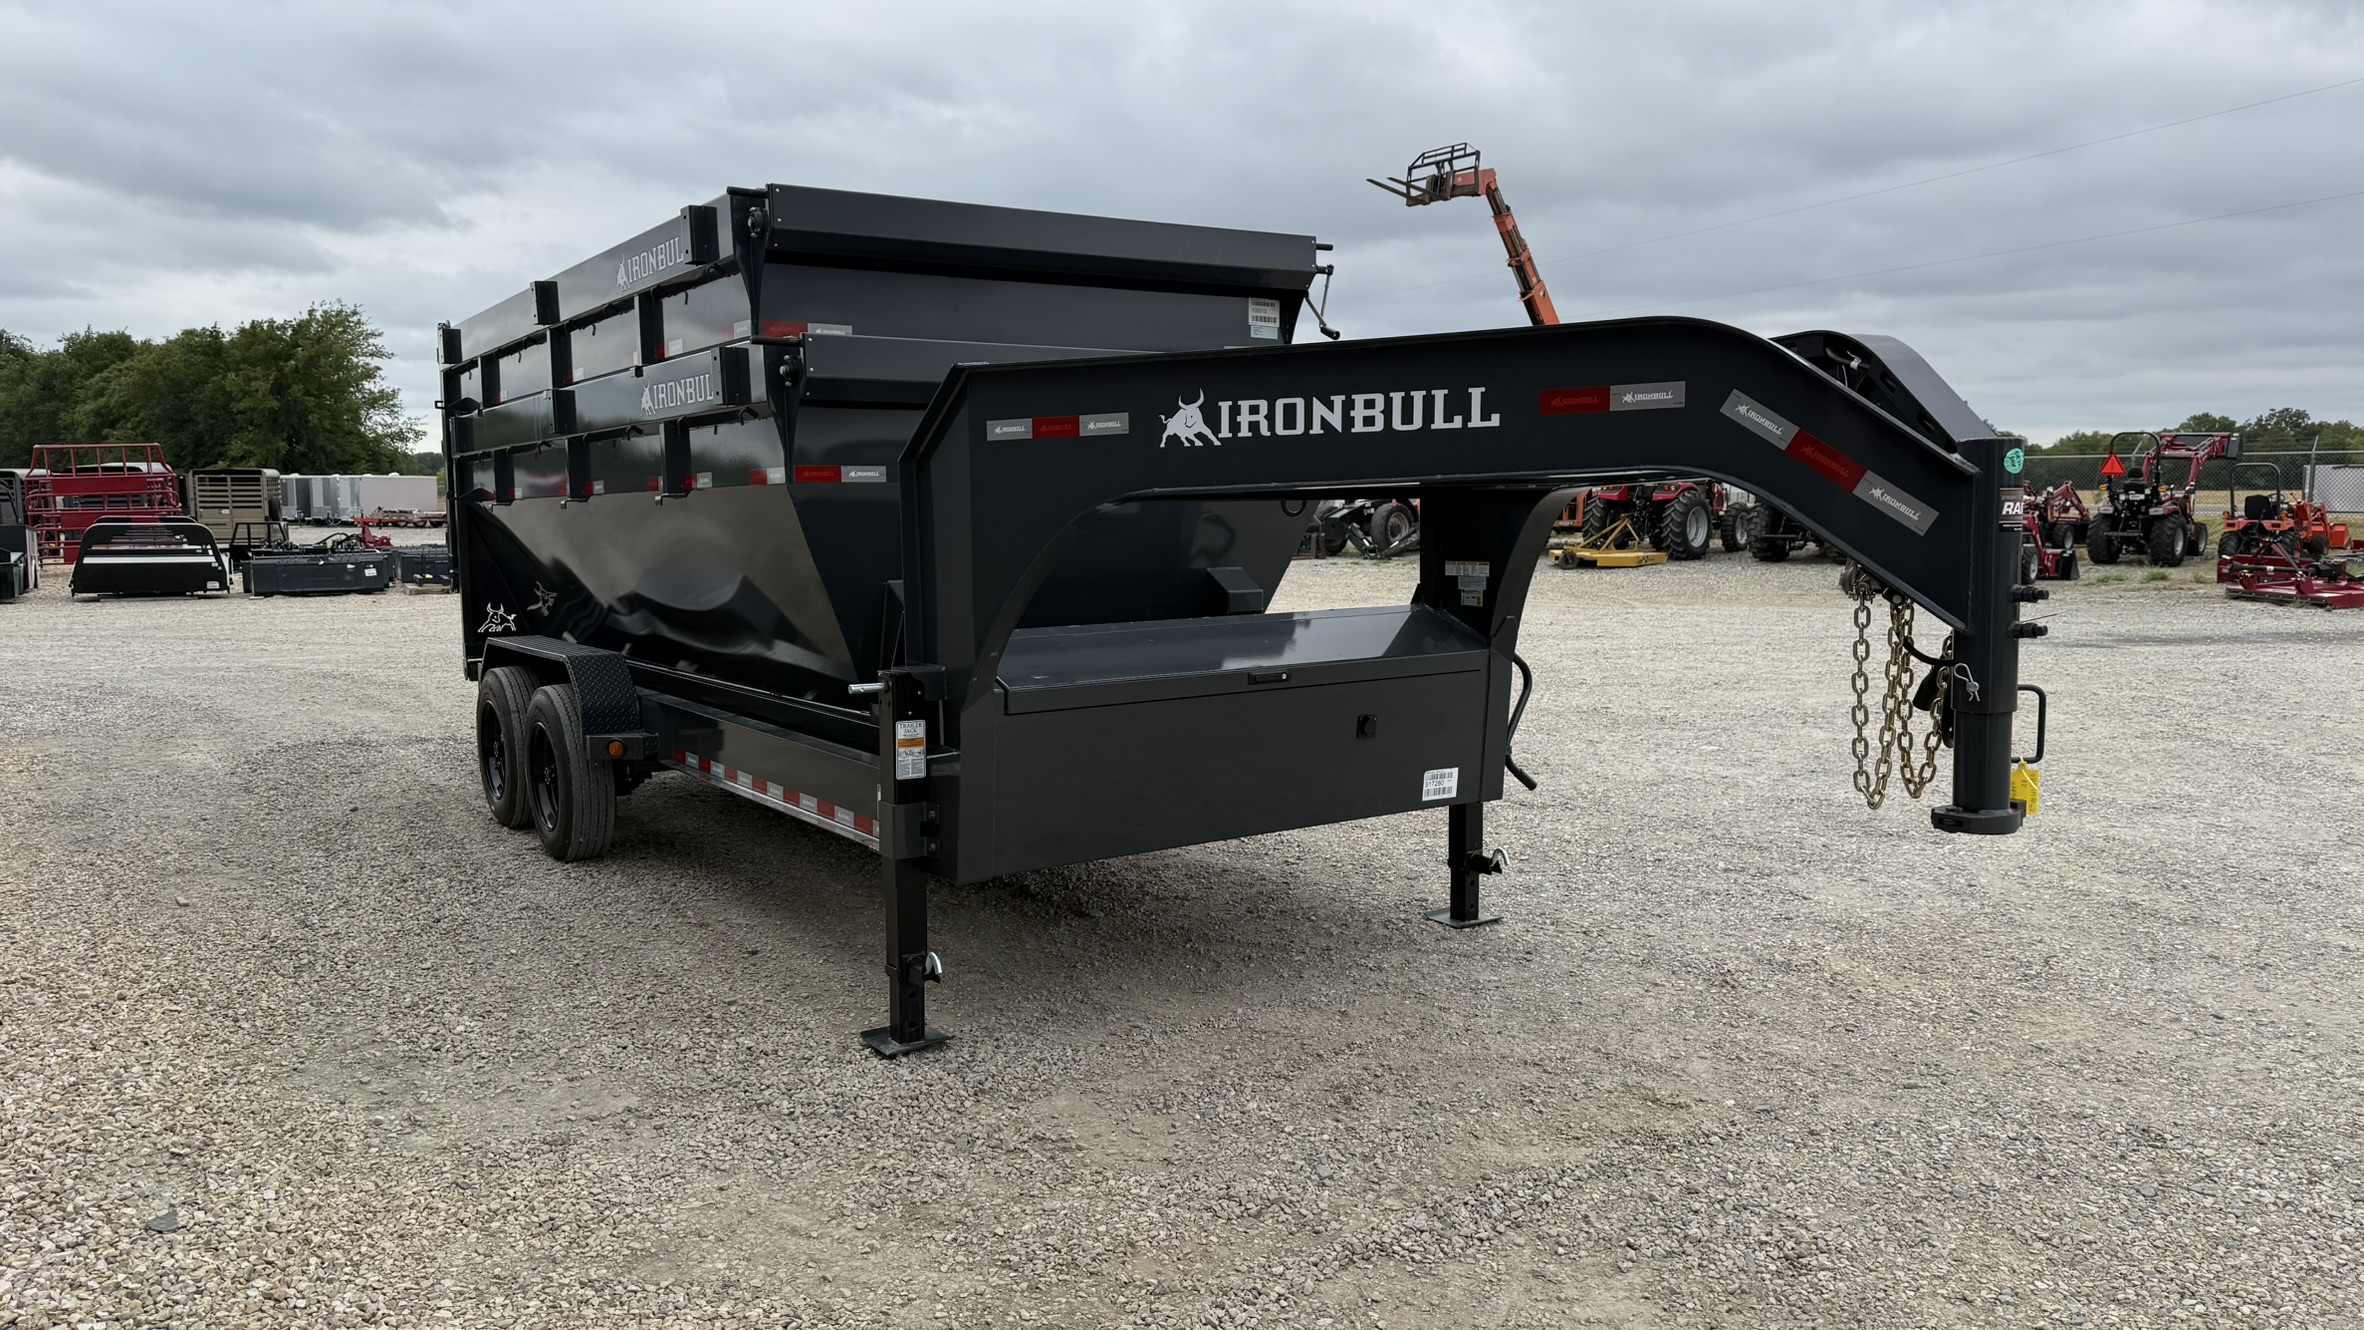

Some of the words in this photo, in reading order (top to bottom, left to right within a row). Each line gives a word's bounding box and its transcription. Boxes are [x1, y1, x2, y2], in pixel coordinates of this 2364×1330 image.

[626, 236, 684, 283] IRONBUL
[653, 373, 714, 410] IRONBUL
[1562, 395, 1599, 405] IRONBULL
[1634, 390, 1674, 401] IRONBULL
[1095, 420, 1122, 429] IRONBULL
[1218, 386, 1501, 438] IRONBULL
[1748, 410, 1784, 435] IRONBULL
[1002, 424, 1026, 433] IRONBULL
[1813, 451, 1849, 477] IRONBULL
[1882, 493, 1921, 521] IRONBULL
